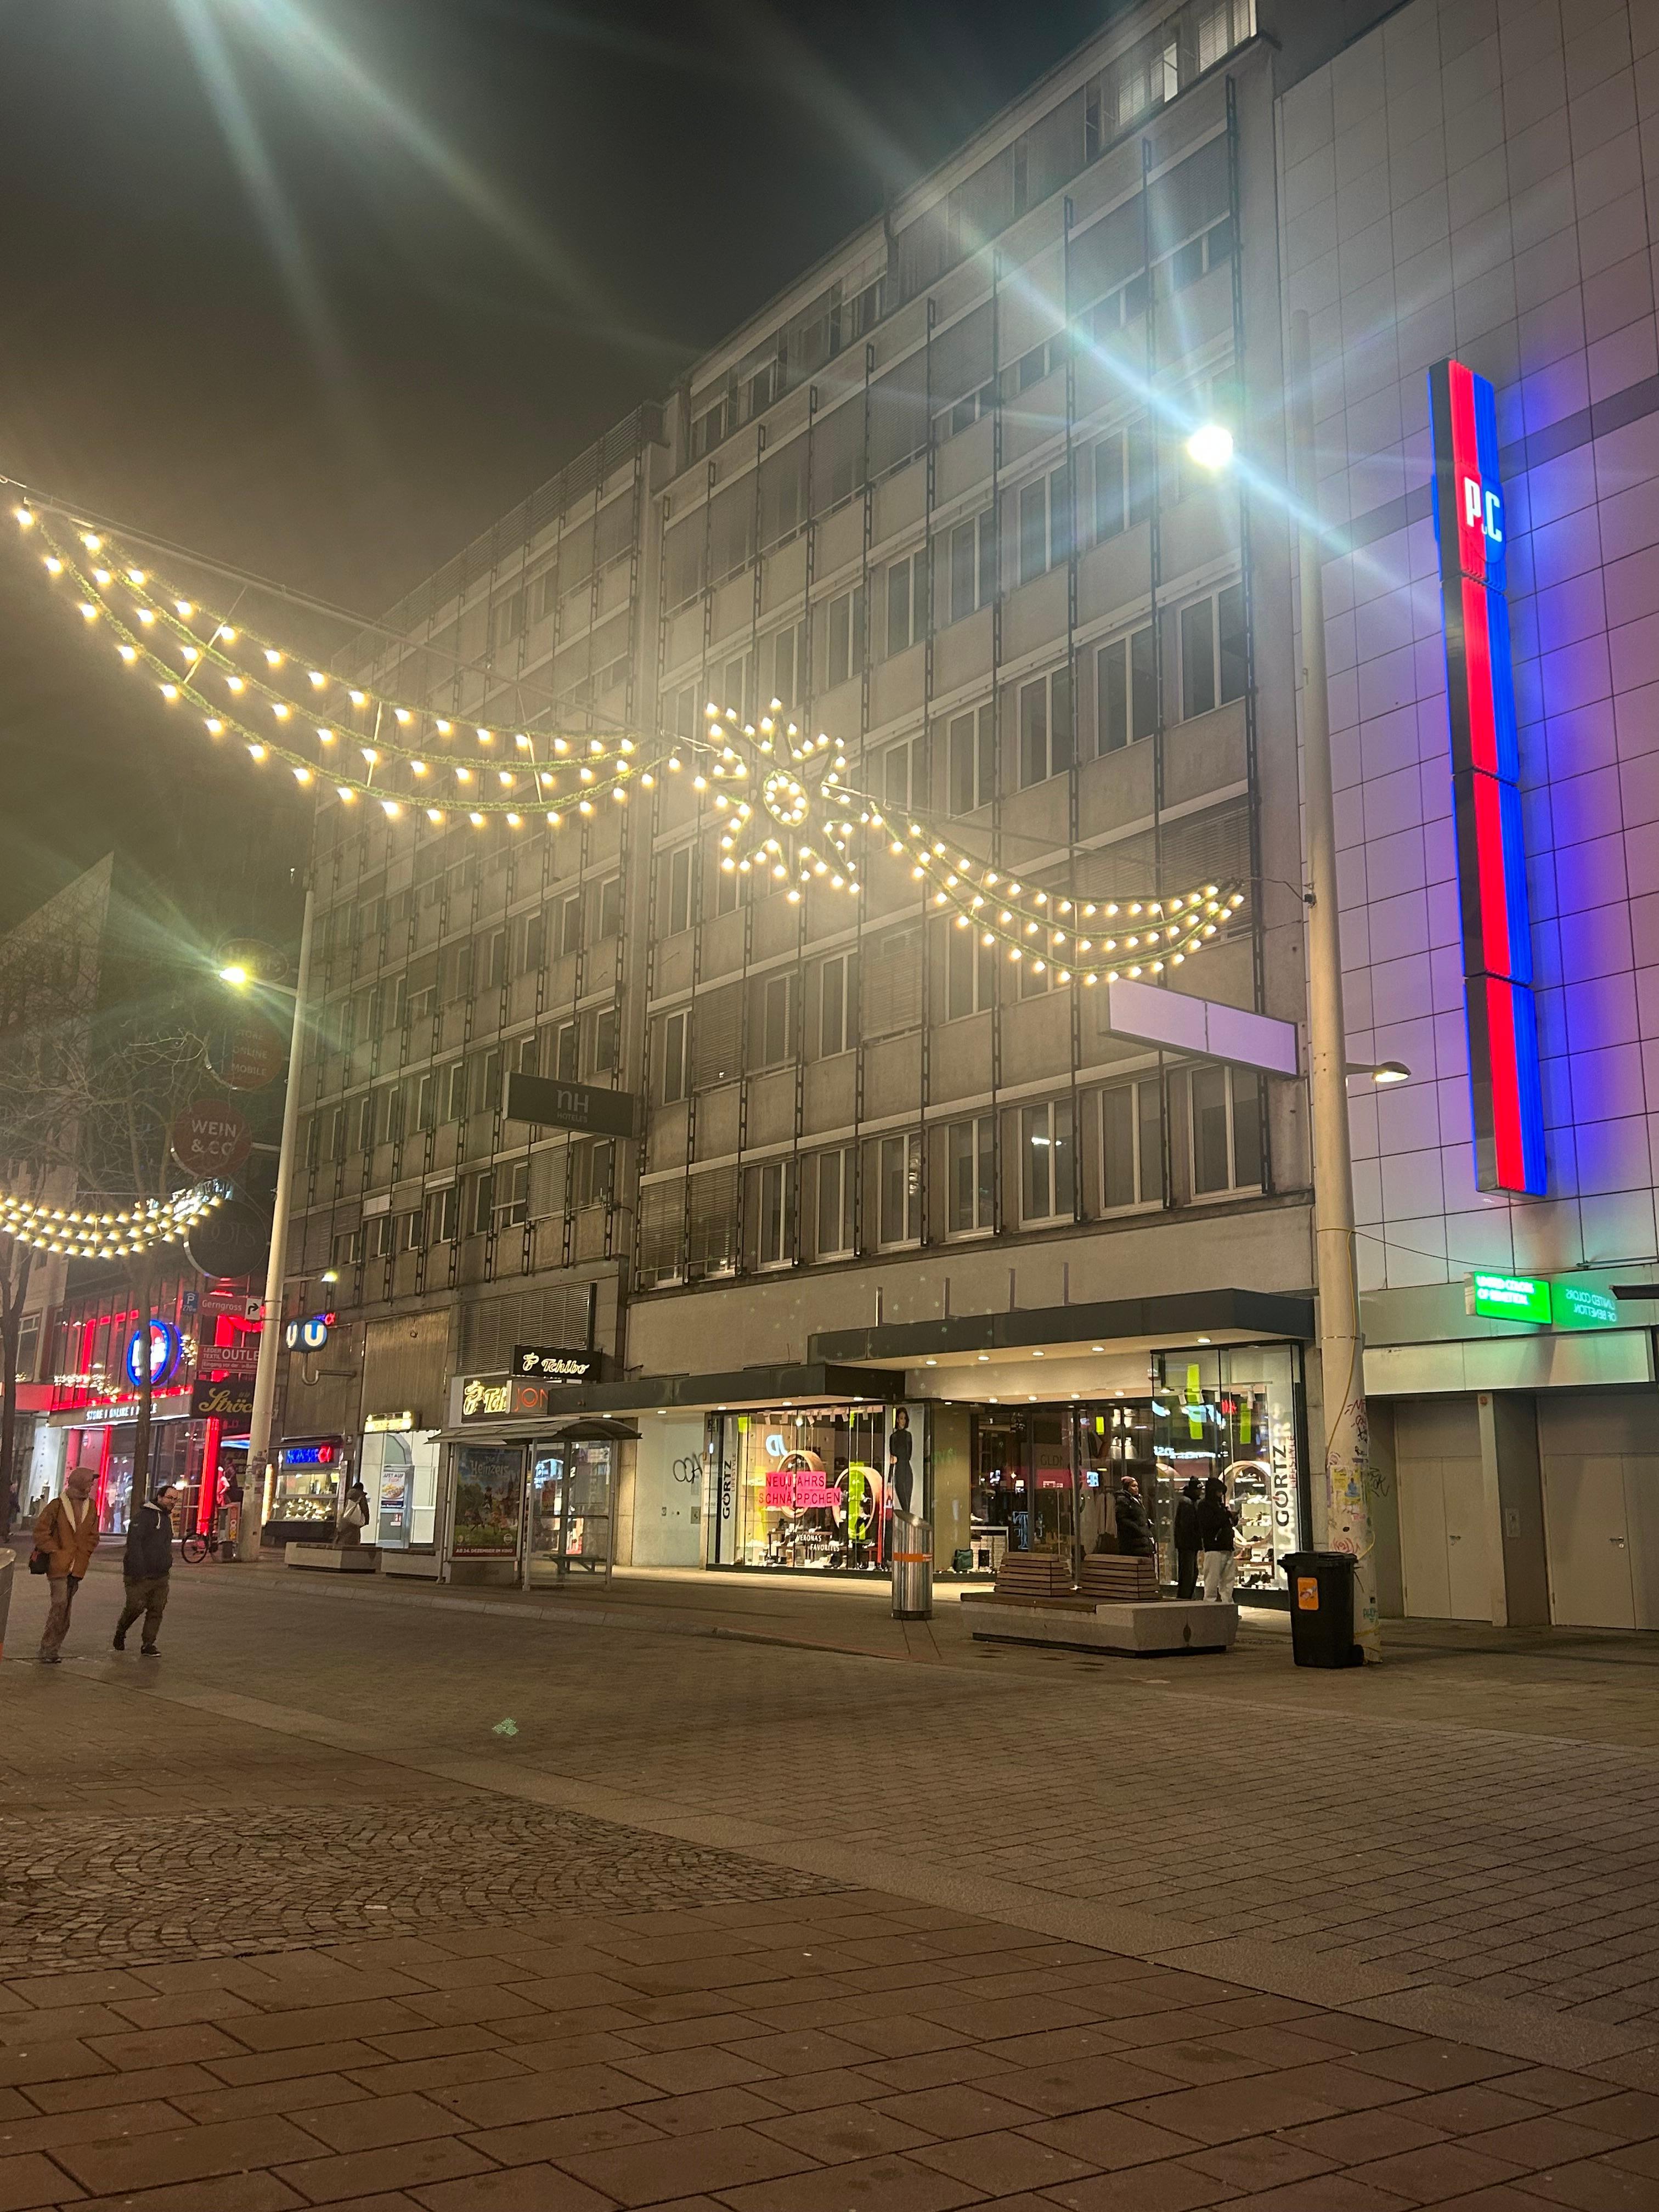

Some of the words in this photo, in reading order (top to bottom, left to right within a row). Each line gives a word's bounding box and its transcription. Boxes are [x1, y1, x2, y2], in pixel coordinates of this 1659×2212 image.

[233, 1045, 268, 1059] ONLINE
[232, 1064, 267, 1076] MOBILE
[191, 1119, 237, 1138] WEIN
[191, 1138, 207, 1153] &
[187, 1295, 195, 1305] P
[202, 1299, 242, 1312] Gerngross
[304, 1324, 324, 1347] U
[222, 1348, 259, 1361] OUTLE
[541, 1358, 590, 1375] Tchibo
[198, 1387, 254, 1413] Ströc
[469, 1459, 509, 1476] Heinzels
[759, 1490, 840, 1505] SCHNÄPPCHEN
[810, 1543, 840, 1552] FAVORITES
